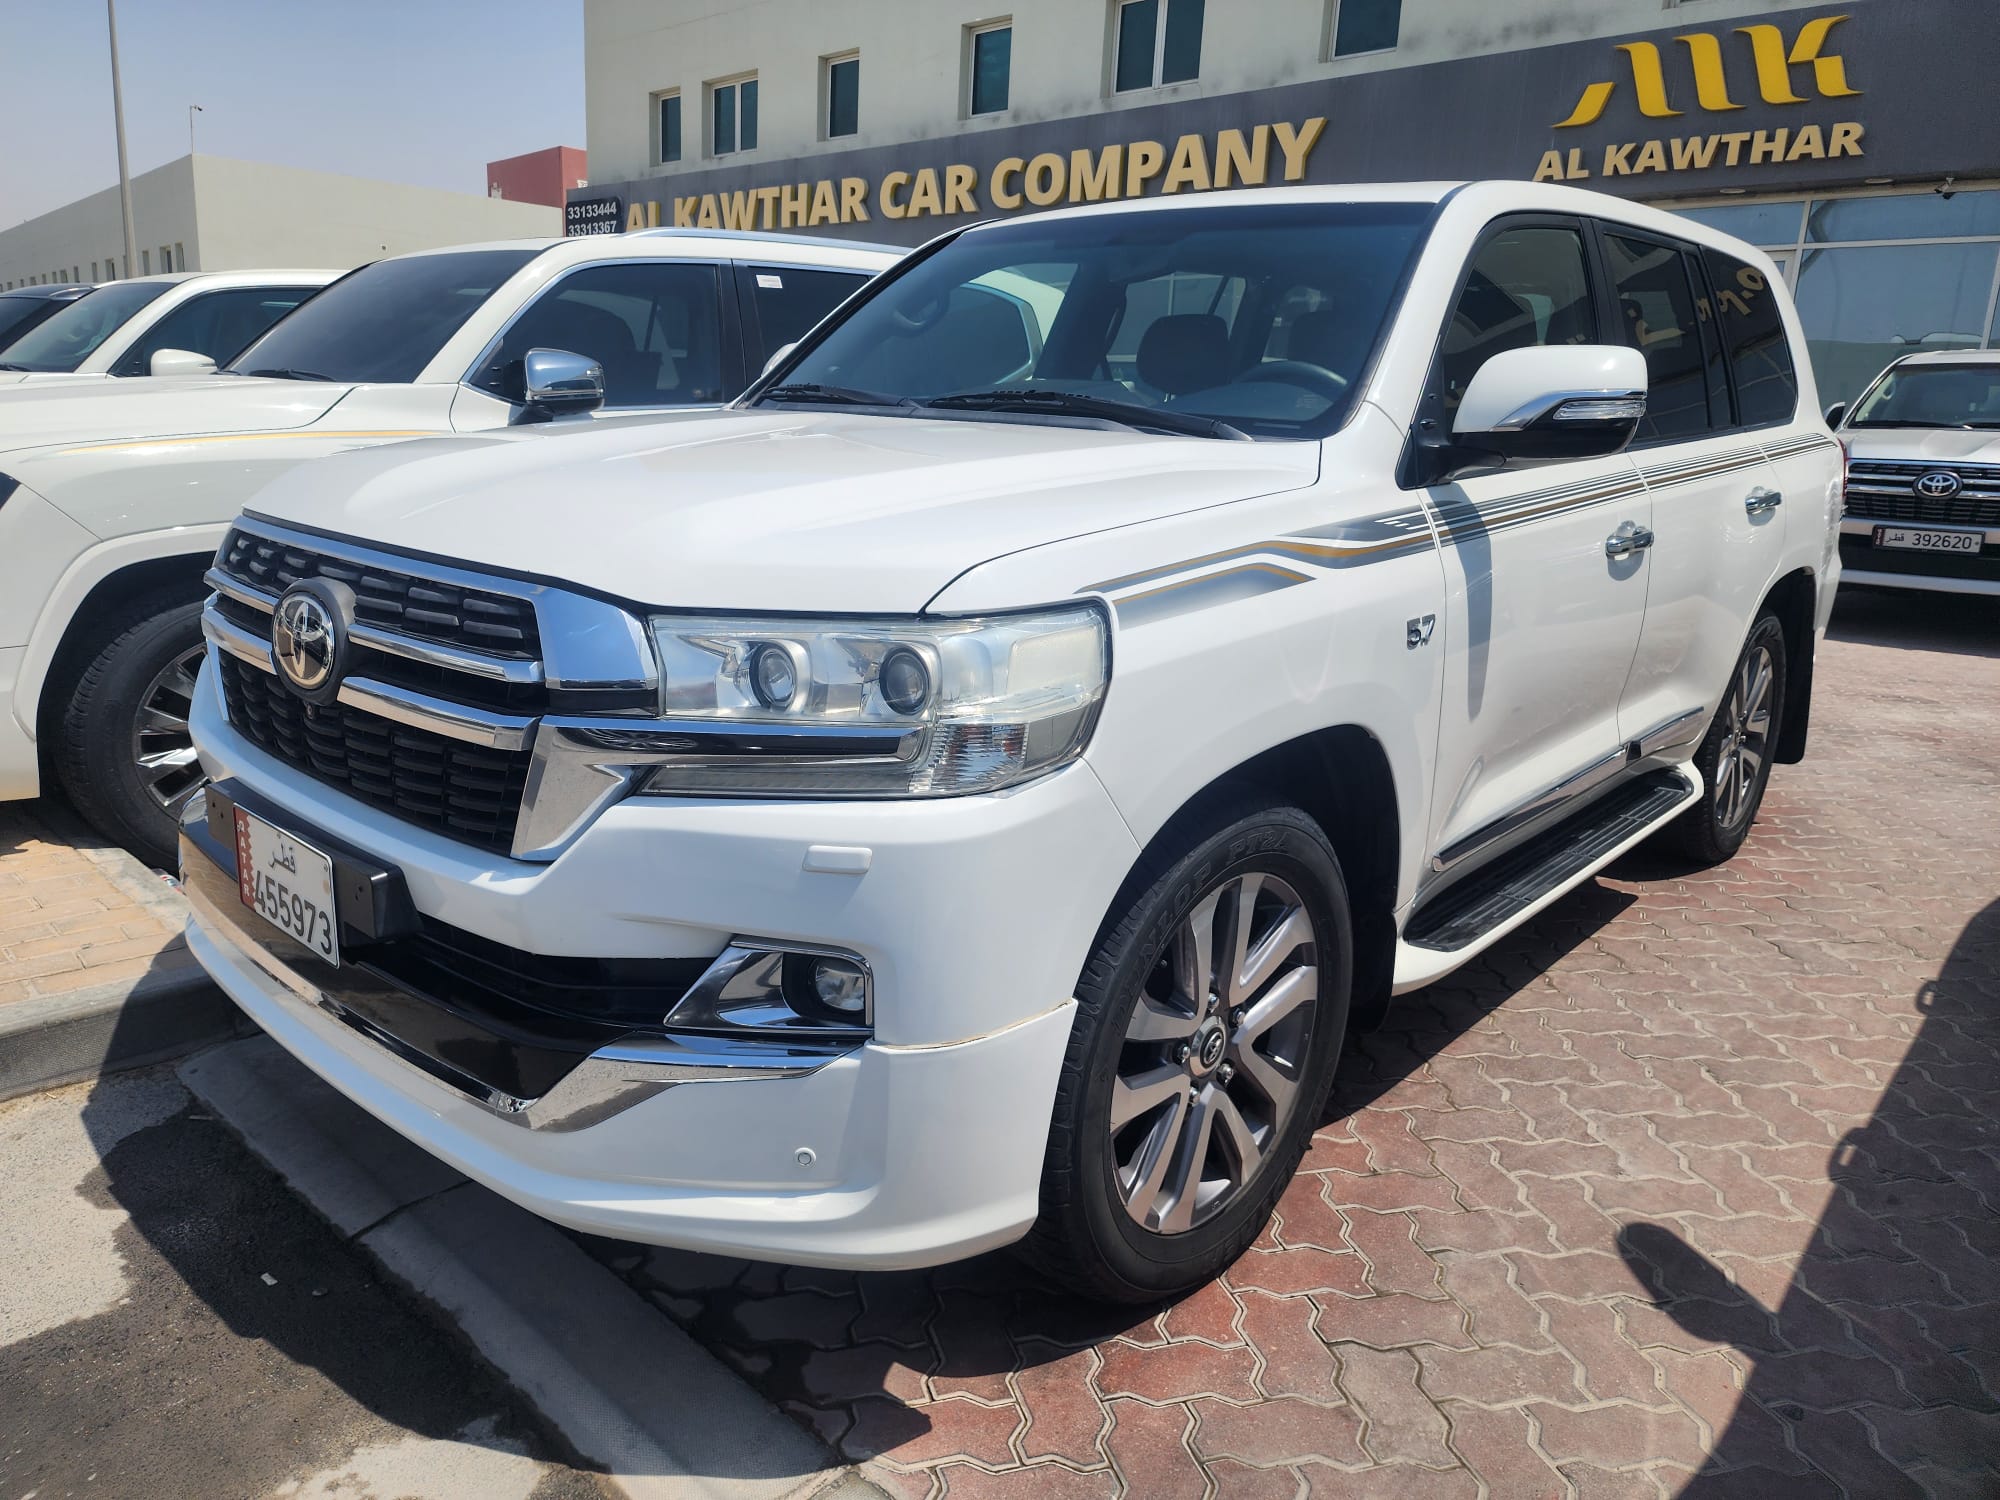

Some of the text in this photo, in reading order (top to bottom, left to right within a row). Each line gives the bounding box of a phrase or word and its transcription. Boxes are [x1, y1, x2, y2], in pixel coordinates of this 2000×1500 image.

[625, 117, 1327, 232] AL KAWTHAR CAR COMPANY
[1533, 121, 1866, 182] AL KAWTHAR
[567, 201, 617, 219] 33133444
[568, 220, 617, 237] 33313367
[1911, 532, 1973, 550] 392620
[237, 819, 251, 897] QATAR
[268, 842, 296, 874] قطر
[254, 870, 332, 955] 455973
